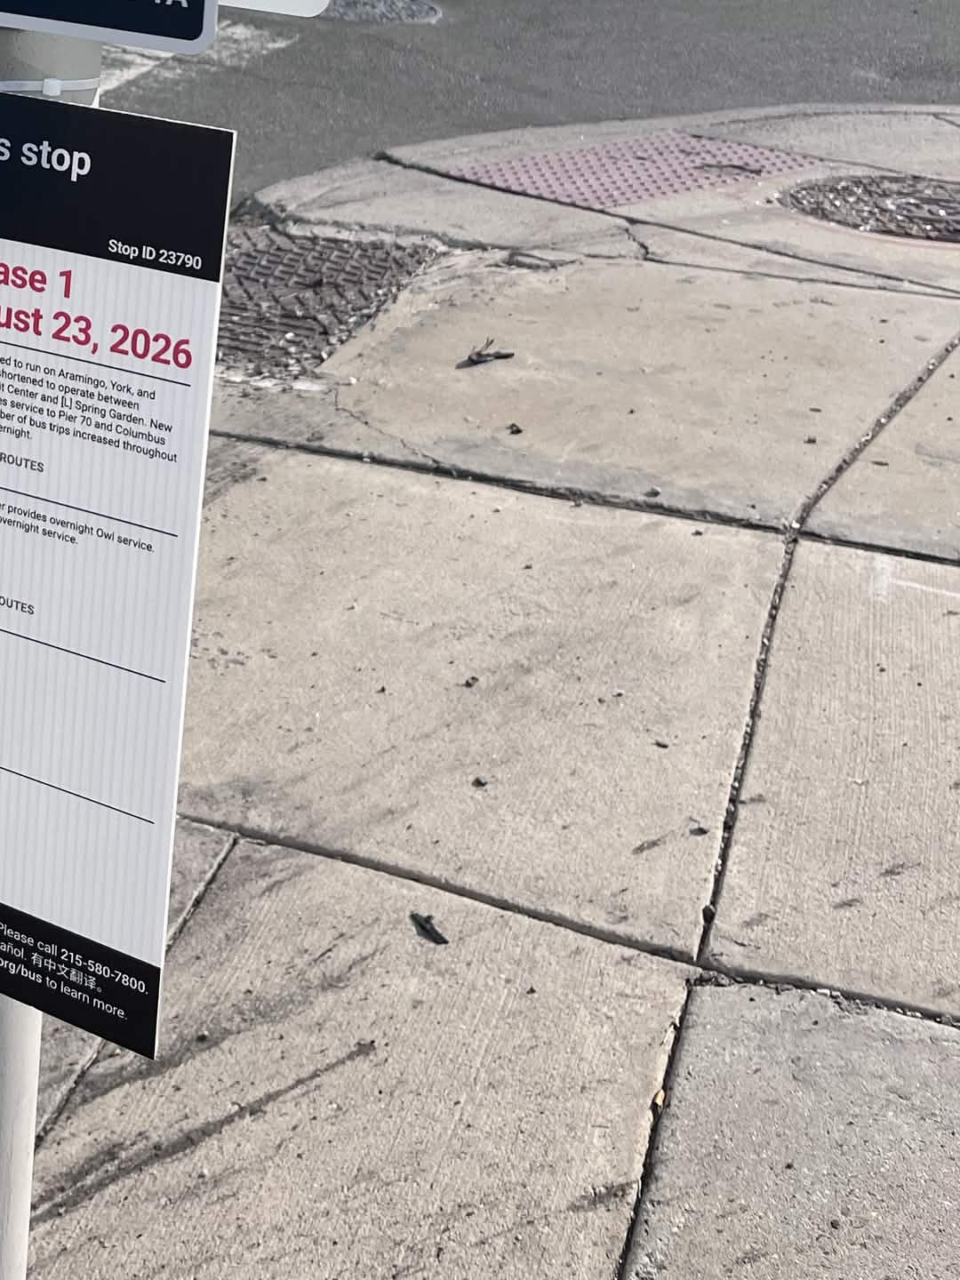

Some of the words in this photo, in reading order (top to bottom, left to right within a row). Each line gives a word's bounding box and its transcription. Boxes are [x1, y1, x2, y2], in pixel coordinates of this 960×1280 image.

[21, 141, 91, 182] stop
[108, 239, 139, 259] Stop
[142, 246, 156, 260] ID
[159, 250, 202, 270] 23790
[59, 270, 72, 299] 1
[52, 312, 98, 355] 23,
[110, 324, 192, 369] 2026
[14, 359, 23, 369] to
[26, 362, 41, 372] run
[43, 366, 56, 376] on
[58, 368, 108, 390] Aramingo,
[110, 380, 134, 395] York,
[137, 387, 155, 400] and
[46, 379, 56, 390] to
[58, 383, 95, 401] operate
[97, 391, 139, 410] between
[7, 384, 38, 401] Center
[41, 392, 58, 405] and
[75, 400, 106, 419] Spring
[109, 409, 147, 427] Garden.
[150, 419, 172, 432] New
[10, 399, 44, 415] service
[47, 407, 56, 418] to
[58, 410, 78, 423] Pier
[80, 415, 92, 427] 70
[95, 418, 113, 431] and
[115, 425, 165, 446] Columbus
[17, 413, 27, 423] of
[30, 416, 47, 429] bus
[49, 421, 70, 436] trips
[73, 429, 120, 448] increased
[123, 440, 177, 462] throughout
[0, 452, 44, 472] ROUTES
[8, 505, 47, 522] provides
[50, 516, 94, 535] overnight
[96, 527, 115, 541] Owl
[117, 533, 154, 552] service.
[42, 526, 78, 544] service.
[37, 940, 58, 956] call
[61, 948, 148, 994] 215-580-7800.
[45, 976, 57, 990] to
[61, 982, 89, 1004] learn
[93, 998, 128, 1020] more.
